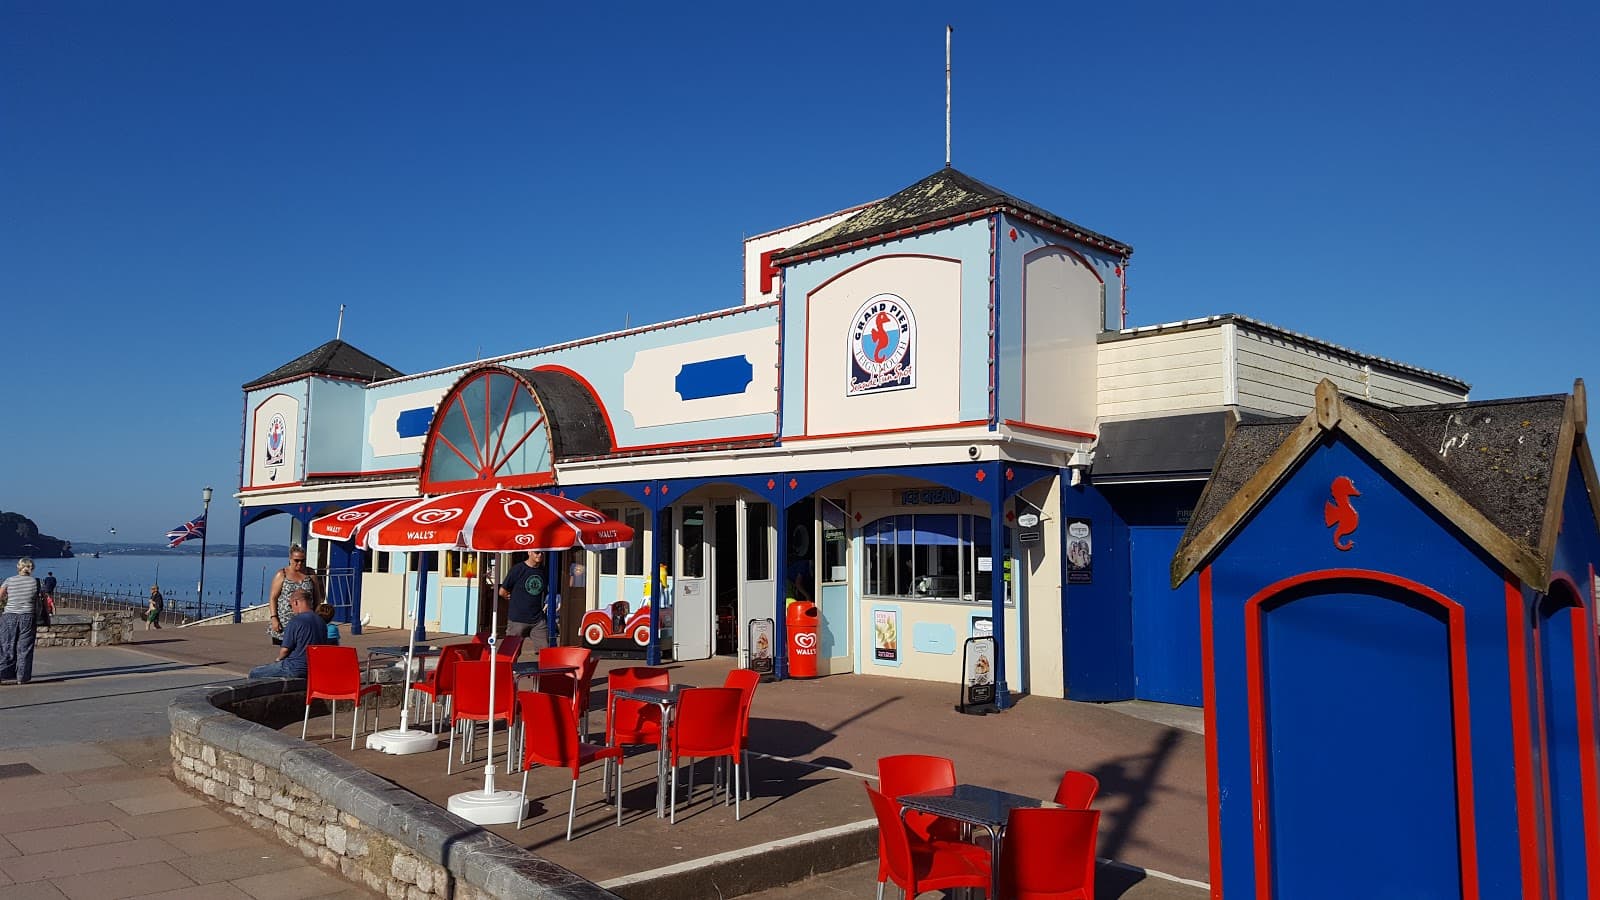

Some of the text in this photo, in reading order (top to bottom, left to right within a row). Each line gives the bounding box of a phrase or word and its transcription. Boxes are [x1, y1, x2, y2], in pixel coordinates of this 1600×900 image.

[855, 303, 908, 340] GRAND PIER
[856, 341, 906, 373] TEIGNMOUTH
[893, 364, 912, 384] Spot
[902, 488, 961, 504] ICE CREAM
[407, 530, 436, 540] WALL'S
